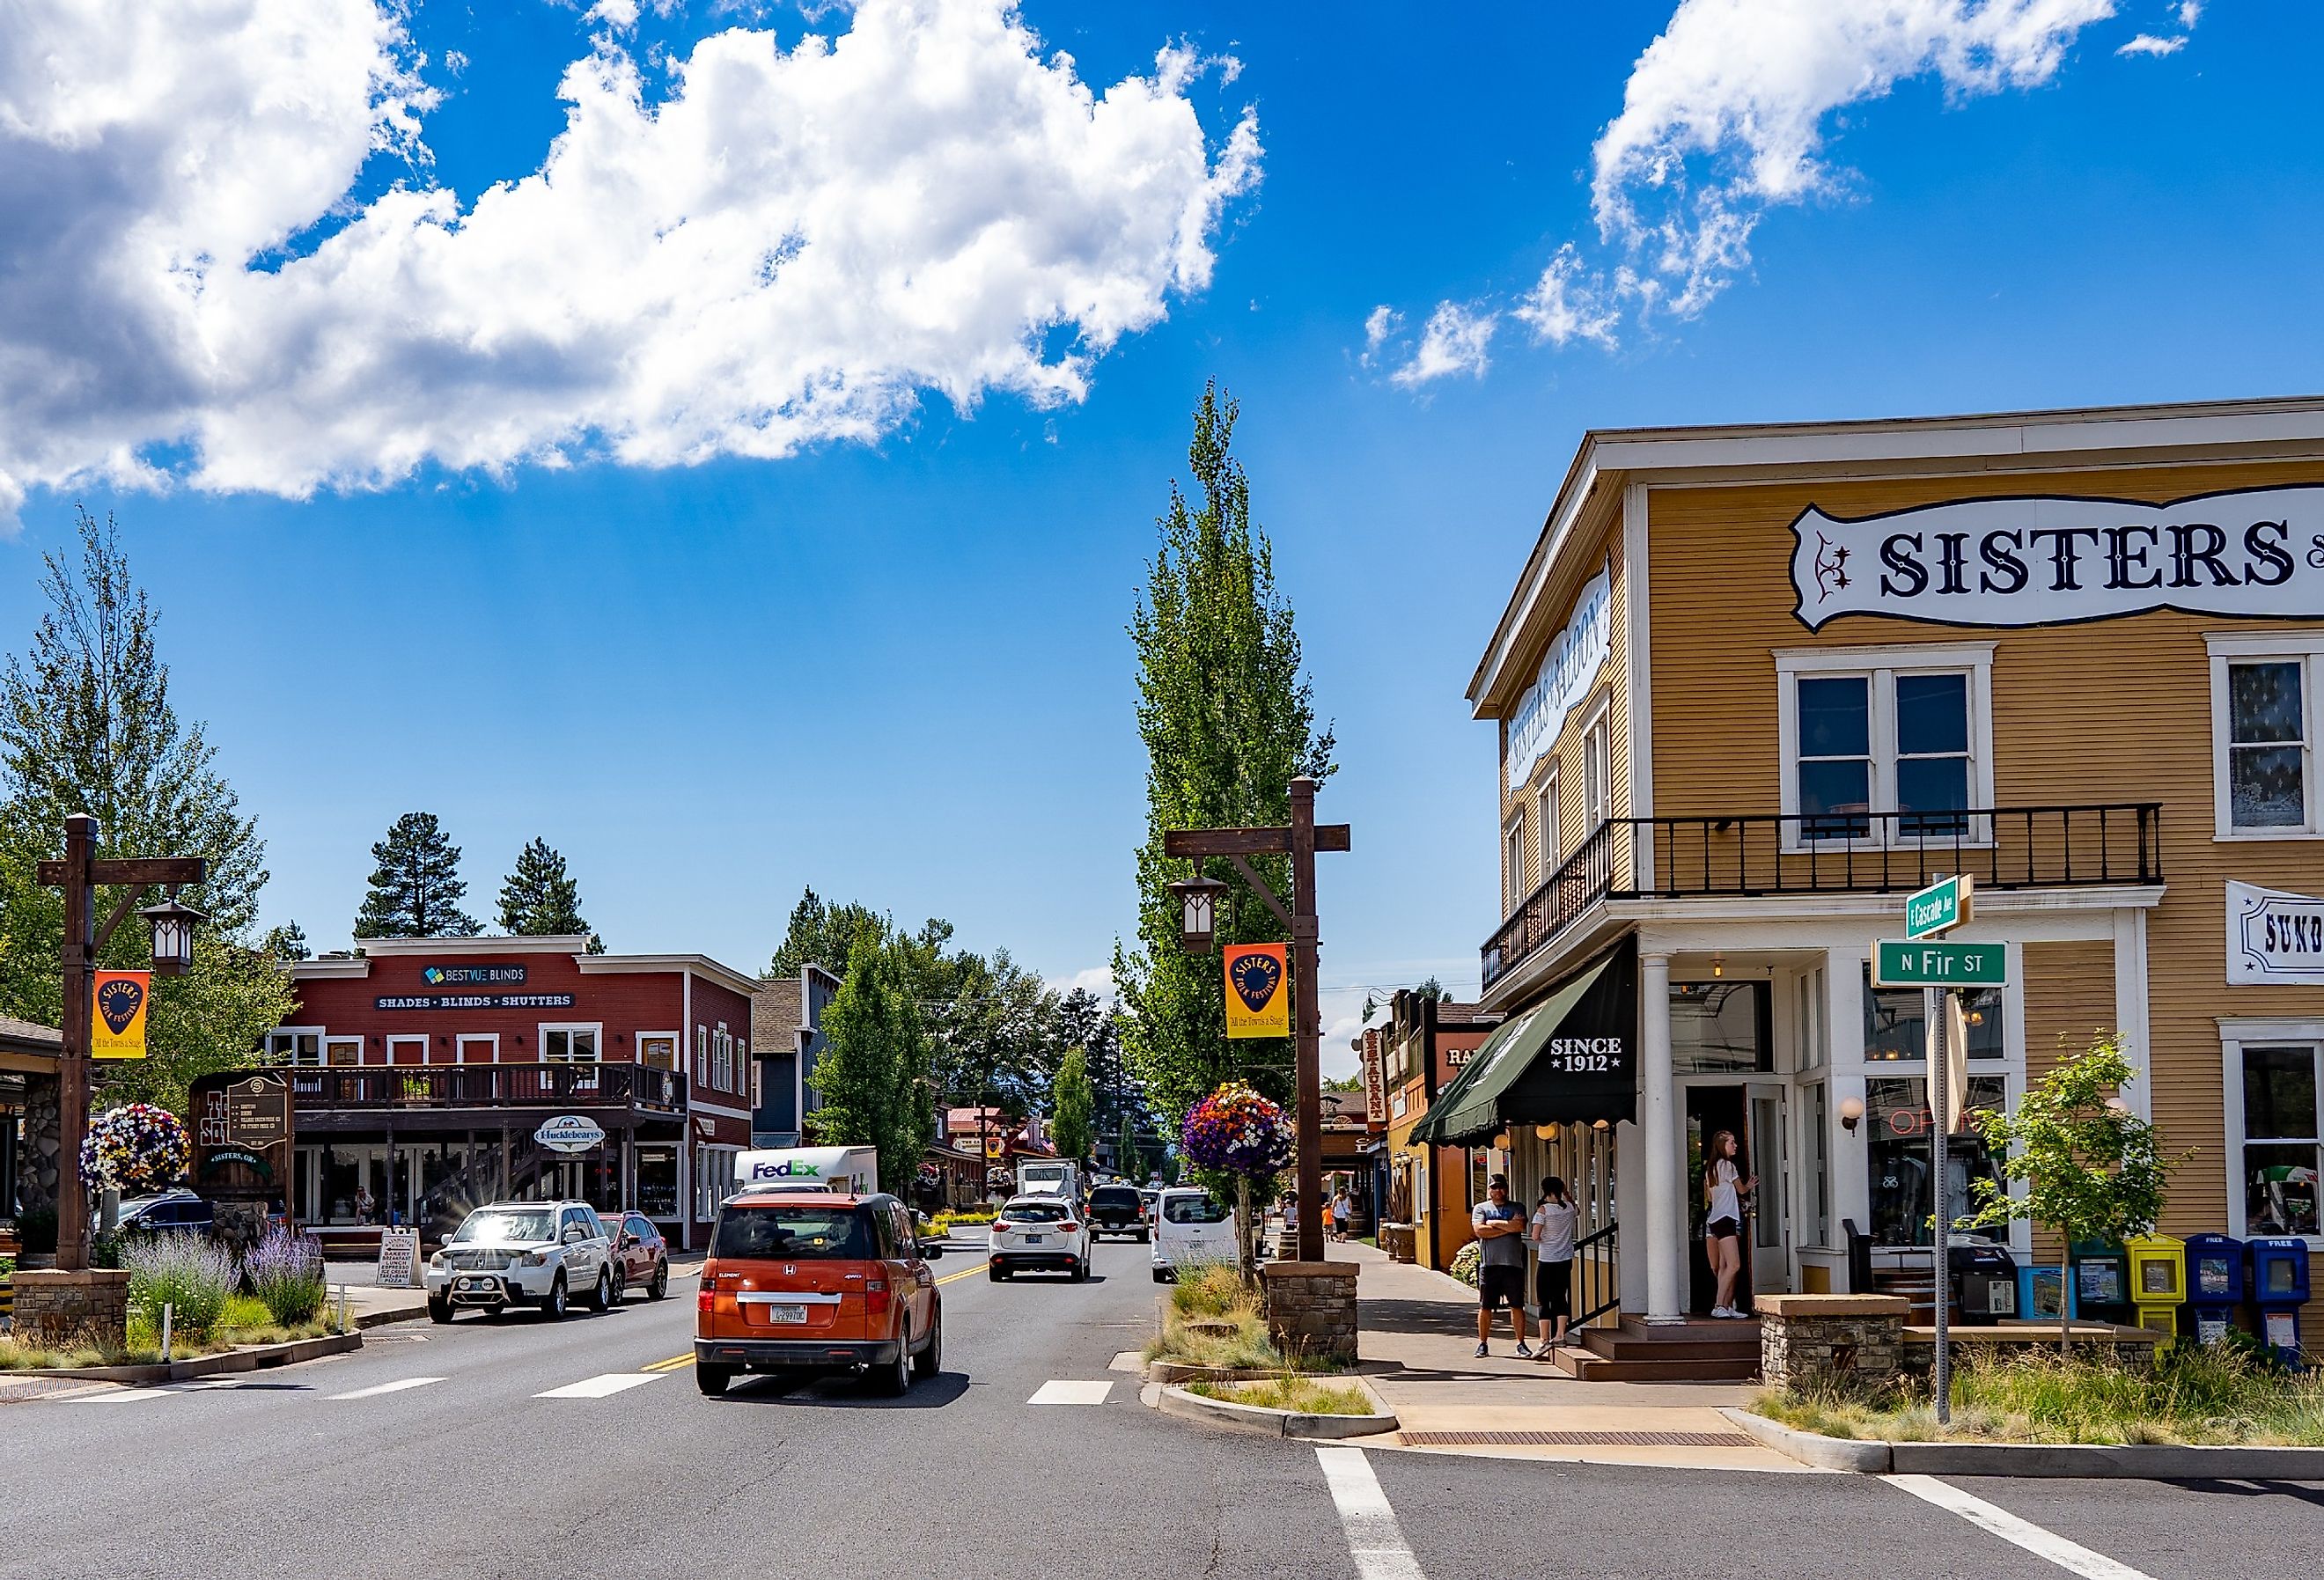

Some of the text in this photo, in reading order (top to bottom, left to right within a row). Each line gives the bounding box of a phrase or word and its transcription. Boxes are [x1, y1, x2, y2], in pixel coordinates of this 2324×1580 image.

[1879, 519, 2295, 598] SISTERS
[1554, 591, 1601, 710] SALOON
[1911, 896, 1952, 927] E Cascade Ave
[2265, 913, 2322, 953] SUND
[1236, 957, 1276, 975] SISTERS
[1901, 951, 1983, 975] N Fir ST
[490, 969, 524, 981] BLINDS
[103, 983, 138, 999] SISTERS
[1236, 976, 1276, 999] FOLK FESTIVAL
[102, 1001, 138, 1022] FOLK FESTIVAL
[379, 995, 570, 1008] SHADES BLINDS SHUTTERS
[1551, 1038, 1622, 1055] SINCE
[1564, 1056, 1607, 1071] 1912
[1365, 1033, 1383, 1118] RESTAURANT
[1890, 1109, 1978, 1134] OPN
[541, 1130, 600, 1141] Hucklebearys
[752, 1160, 820, 1180] FedEx
